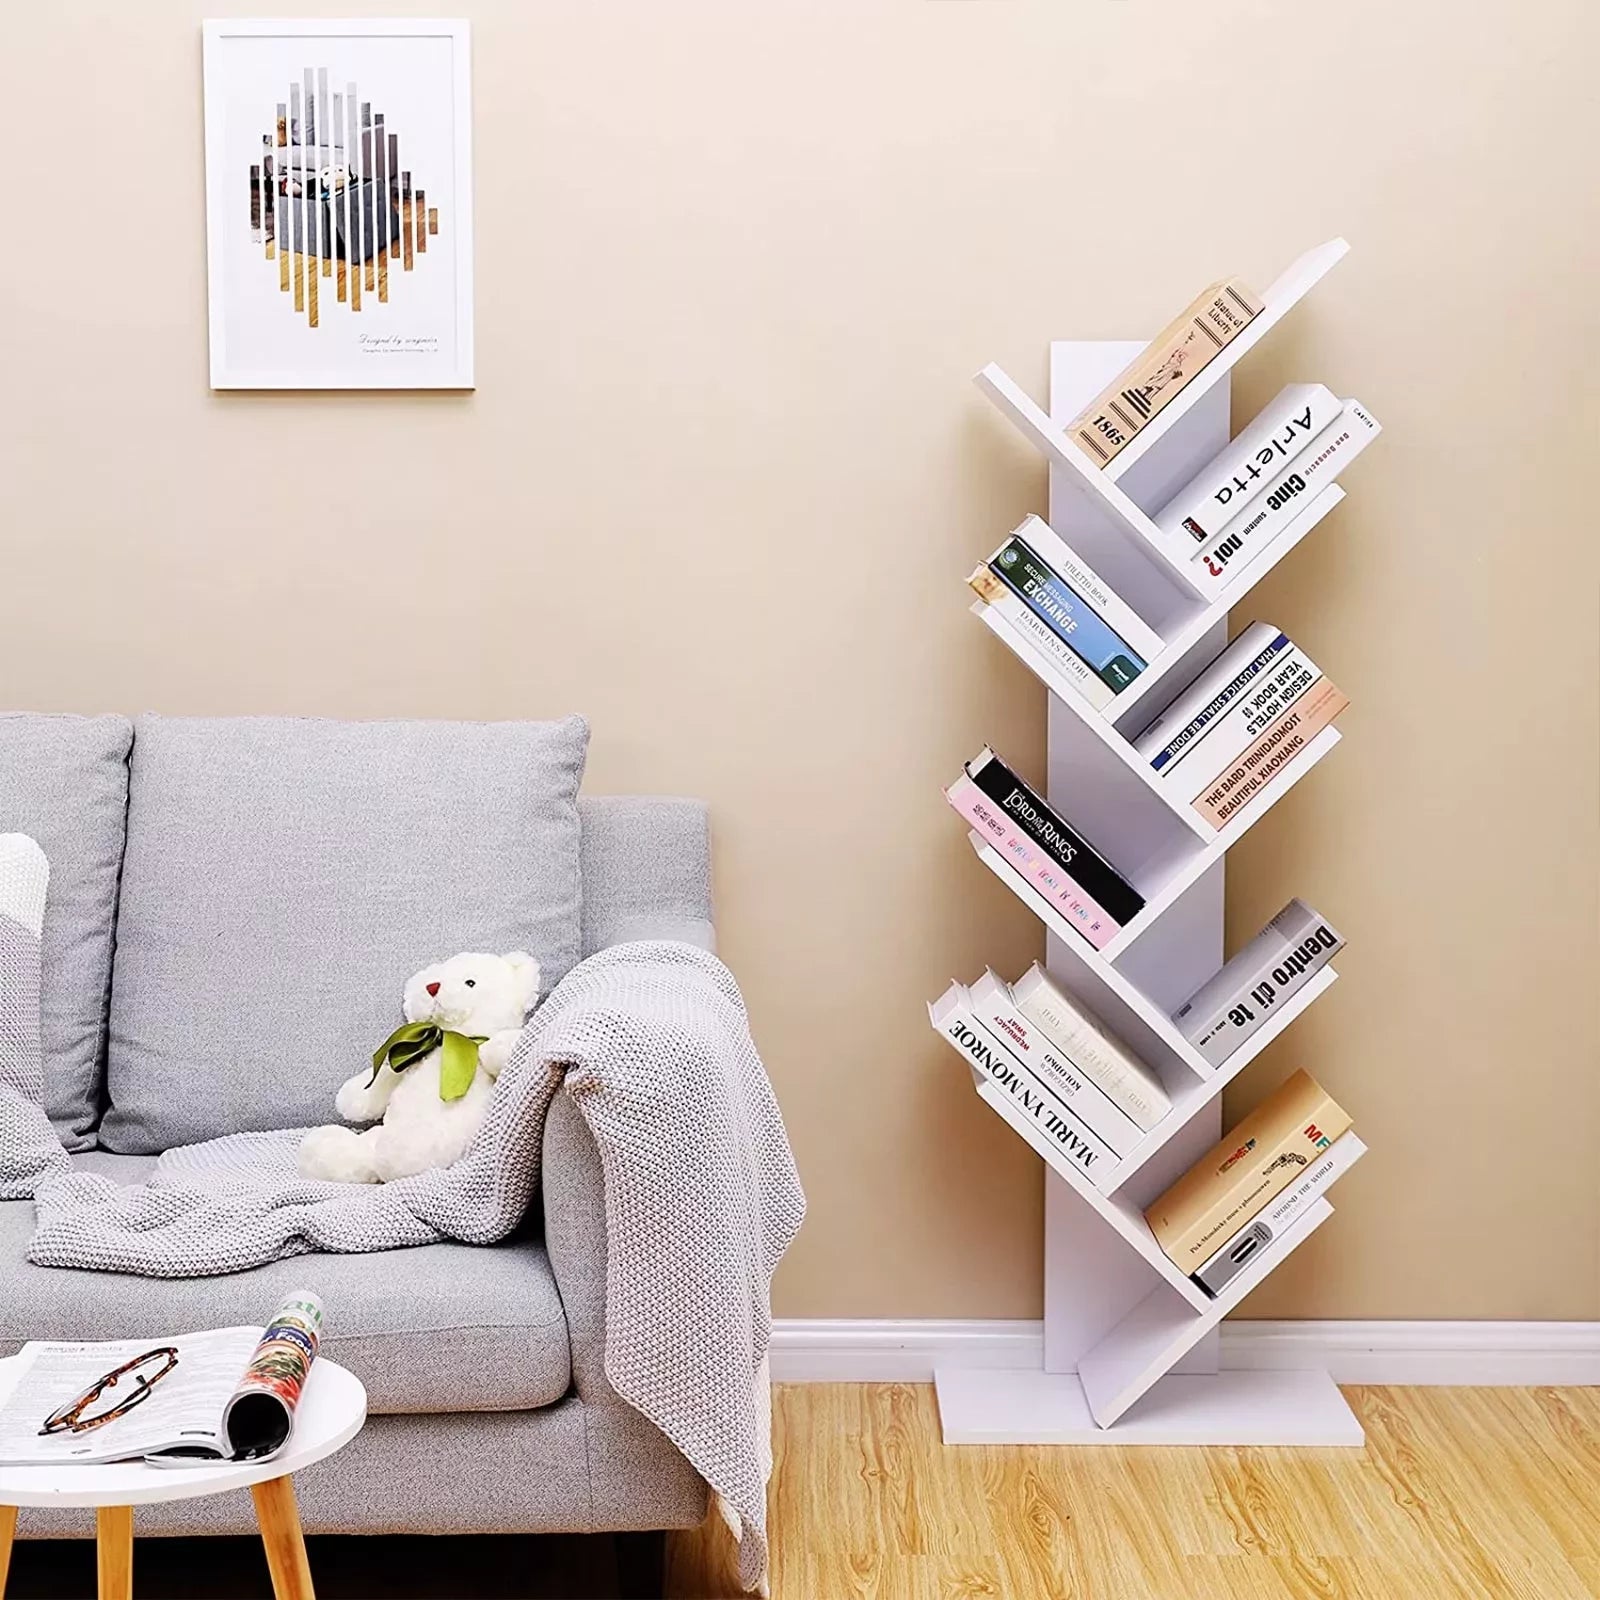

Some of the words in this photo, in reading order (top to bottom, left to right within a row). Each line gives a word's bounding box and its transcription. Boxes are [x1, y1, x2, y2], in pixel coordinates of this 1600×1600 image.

[1208, 308, 1231, 334] Liberty
[1213, 298, 1237, 322] Statue
[1234, 320, 1243, 328] of
[1093, 416, 1125, 445] 1865
[1214, 407, 1311, 505] Arletta
[1267, 474, 1306, 510] Cine
[1243, 512, 1266, 535] suntem
[1203, 534, 1243, 576] noi?
[1024, 564, 1047, 586] SECURE
[1044, 583, 1073, 612] MESSAGING
[1064, 560, 1093, 589] STILETTO
[1091, 588, 1107, 606] BOOK
[1024, 580, 1078, 634] EXCHANGE
[1018, 610, 1061, 653] DARWINS
[1061, 652, 1089, 679] TEORI
[1255, 647, 1280, 673] THAT
[1223, 666, 1258, 702] JUSTICE
[1275, 661, 1302, 686] YEAR
[1279, 670, 1312, 703] DESIGN
[1198, 696, 1228, 726] SHALL
[1251, 683, 1278, 710] BOOK
[1188, 721, 1201, 736] BE
[1247, 700, 1282, 734] HOTELS
[1166, 731, 1191, 759] DONE
[1205, 788, 1225, 806] THE
[1221, 768, 1245, 792] BARD
[1242, 713, 1301, 770] TRINIDADMOST
[1217, 778, 1262, 819] BEAUTIFUL
[1258, 736, 1304, 780] XIAOXIANG
[1002, 788, 1036, 825] LORD
[1039, 822, 1077, 862] RINGS
[1272, 926, 1337, 985] Dentro
[1251, 982, 1275, 1009] di
[1228, 1004, 1255, 1026] te
[949, 1021, 1023, 1094] MONROE
[1272, 1194, 1299, 1219] AROUND
[1298, 1184, 1310, 1195] THE
[1310, 1161, 1334, 1183] WORLD
